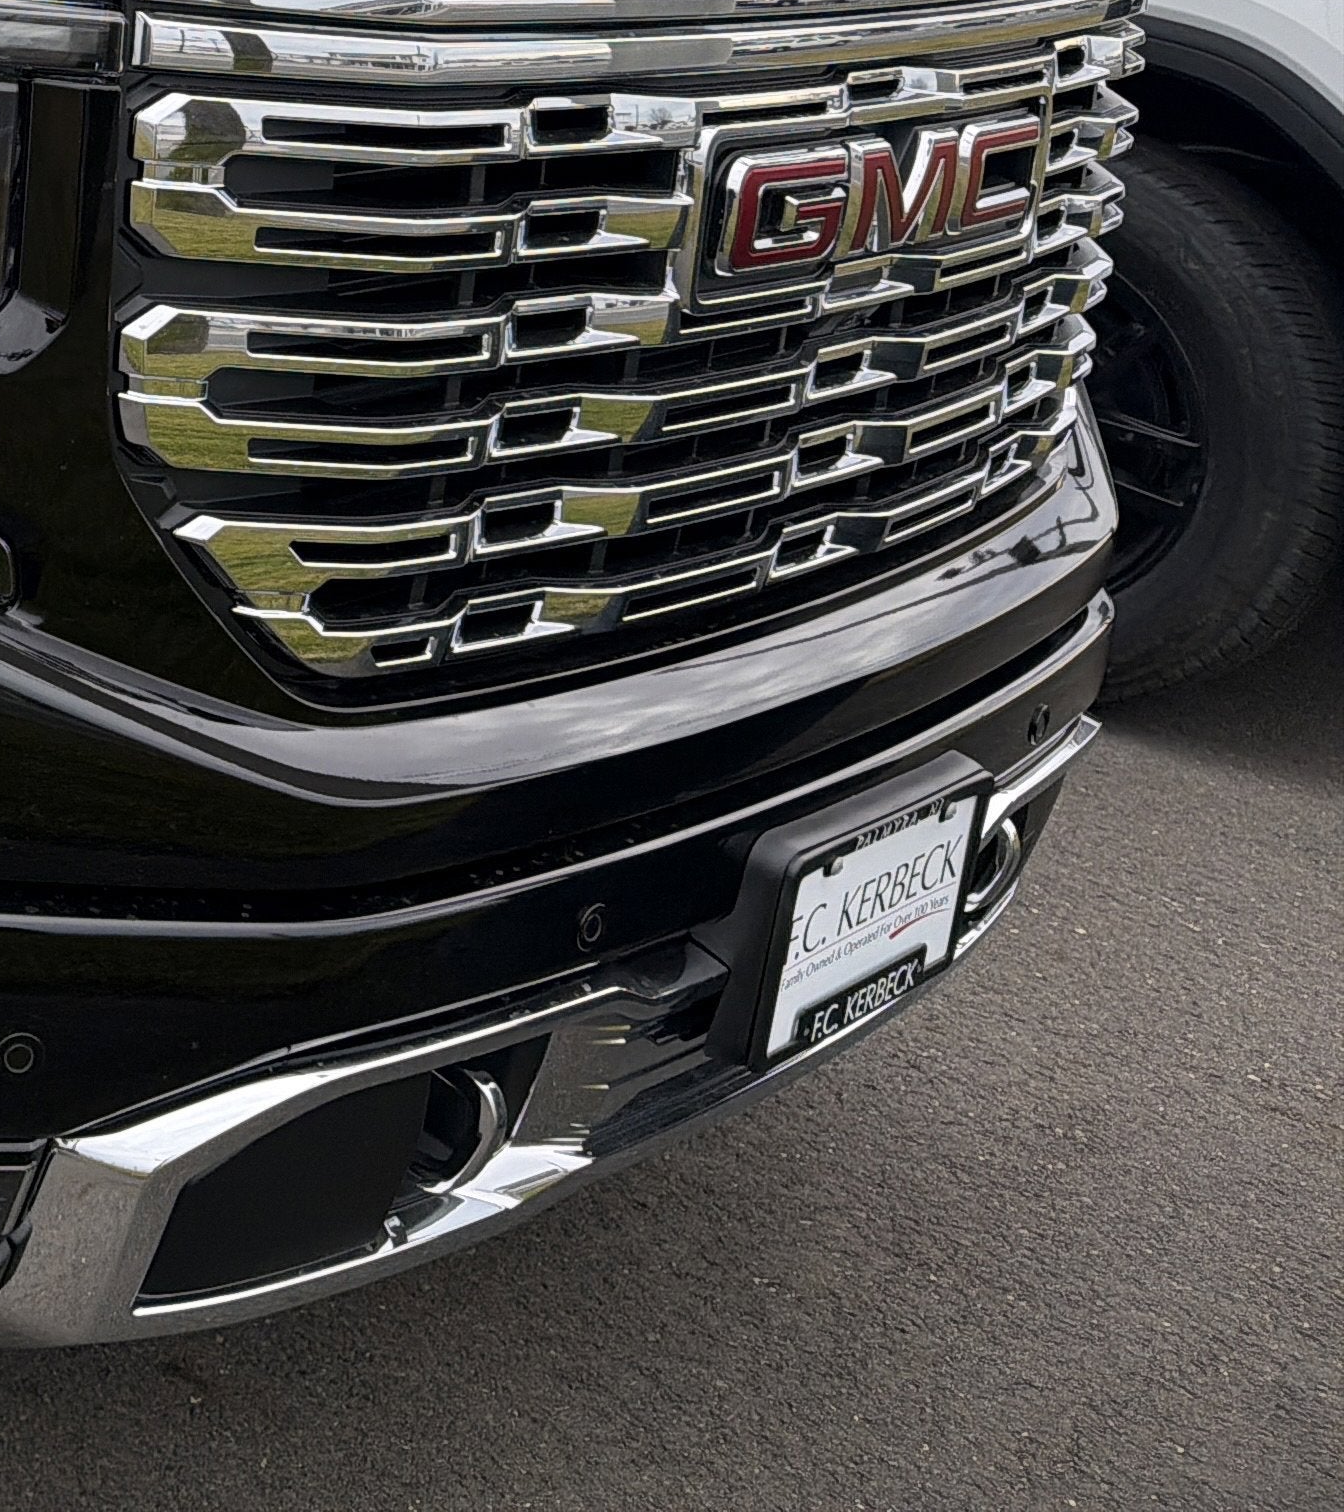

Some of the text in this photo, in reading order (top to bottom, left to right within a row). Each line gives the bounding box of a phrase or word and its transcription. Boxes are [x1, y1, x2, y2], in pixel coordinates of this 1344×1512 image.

[714, 115, 1041, 277] GMC
[836, 834, 963, 937] KERBECK
[843, 958, 919, 1025] KERBECK
